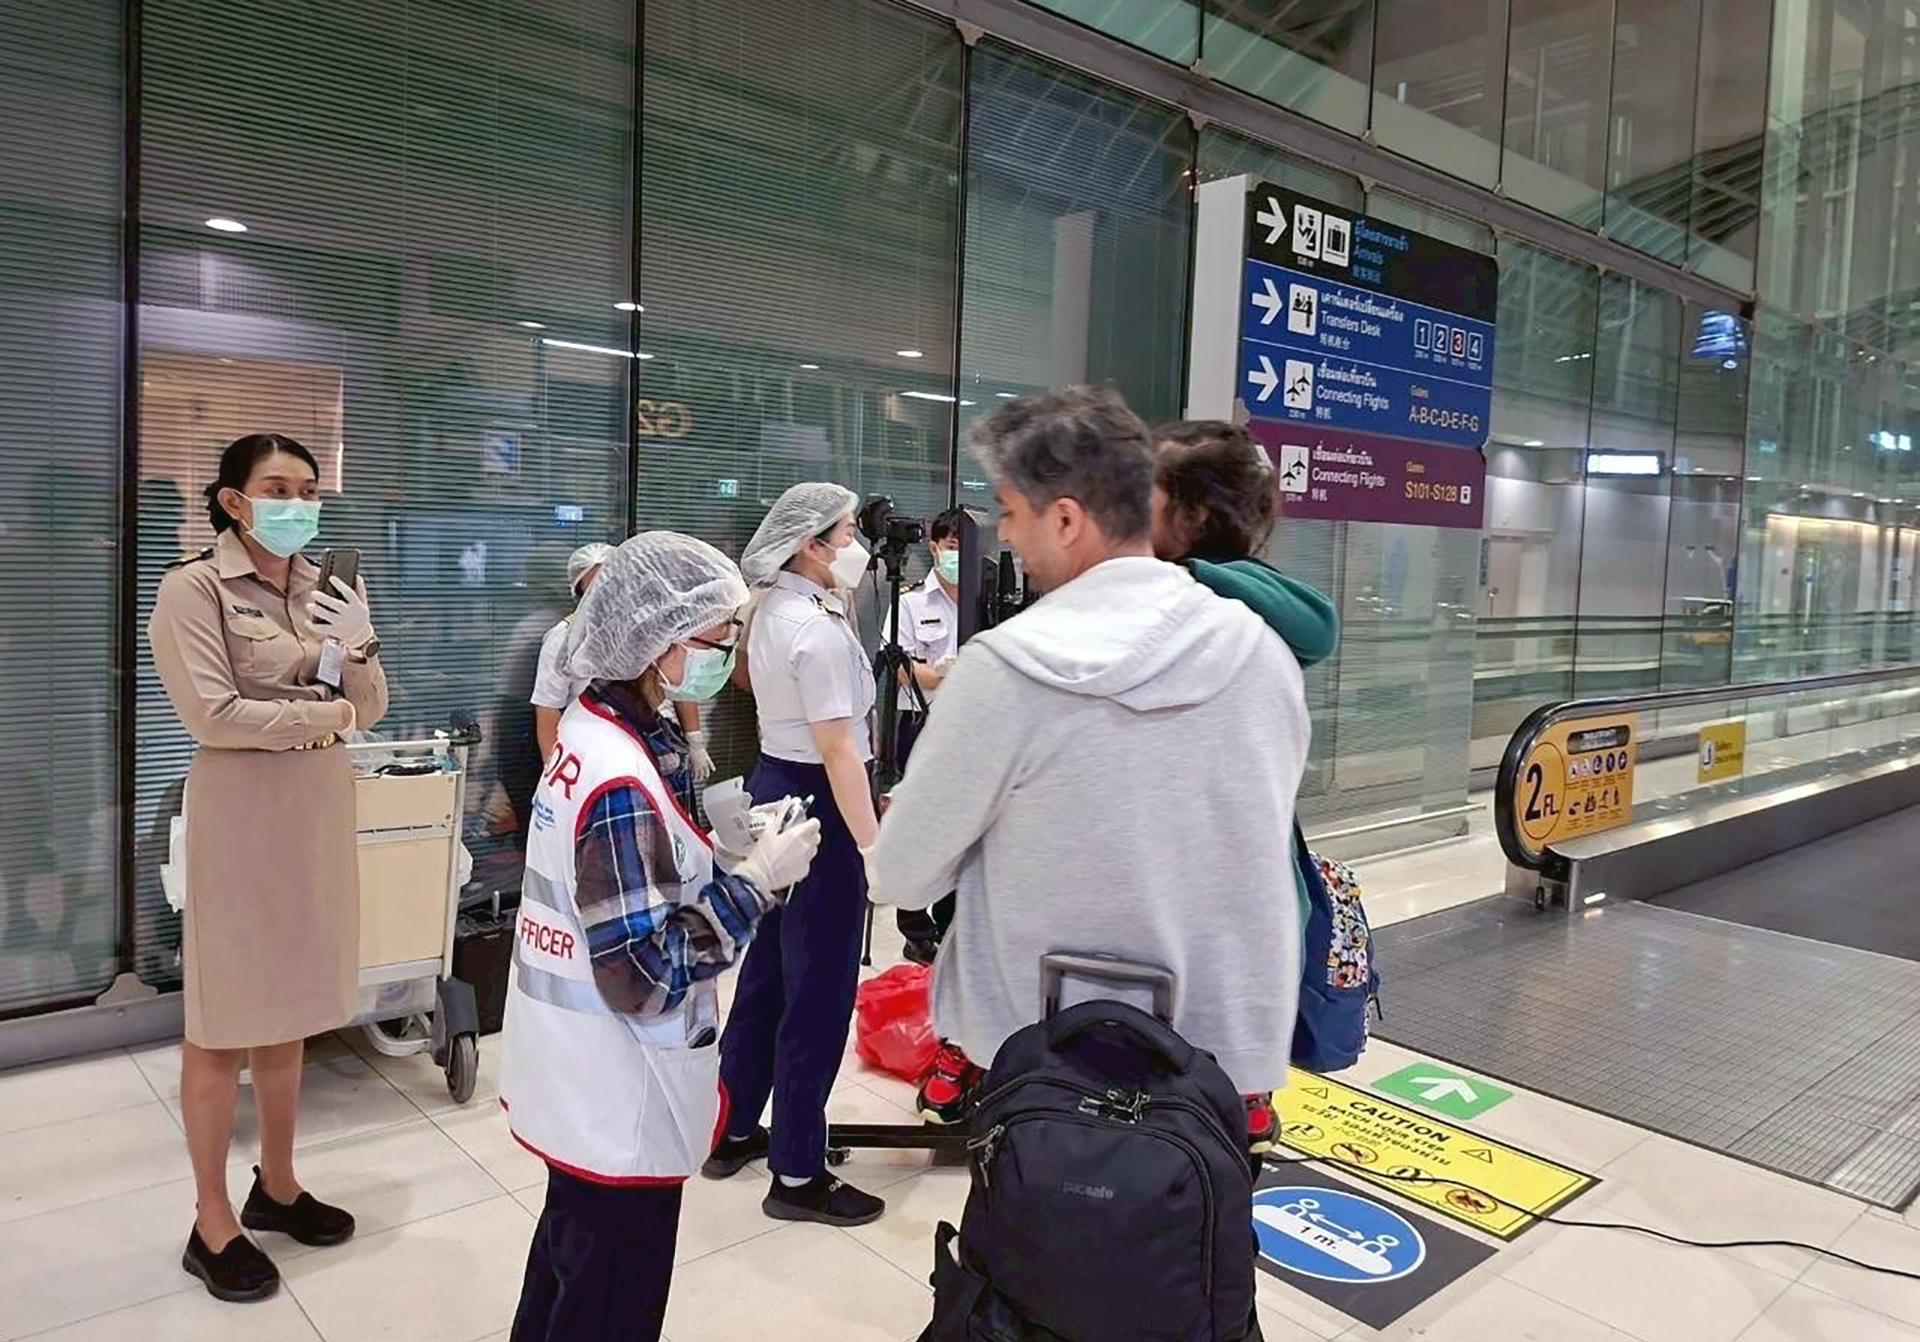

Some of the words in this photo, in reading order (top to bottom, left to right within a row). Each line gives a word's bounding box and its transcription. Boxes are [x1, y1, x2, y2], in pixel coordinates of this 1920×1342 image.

[1321, 310, 1360, 333] Transfers
[1360, 319, 1382, 337] Desk
[1419, 327, 1426, 344] 1
[1436, 330, 1445, 348] 2
[1454, 333, 1462, 351] 3
[1471, 338, 1479, 356] 4
[1316, 384, 1362, 409] Connecting
[1363, 392, 1390, 412] Flights
[1408, 405, 1479, 432] A-B-C-D-E-F-G
[1312, 467, 1359, 488] Connecting
[1360, 471, 1386, 489] Flights
[1525, 763, 1542, 821] 2
[1327, 1105, 1371, 1124] WATCH
[1374, 1122, 1410, 1140] YOUR
[1412, 1137, 1446, 1152] STEP
[1349, 1101, 1452, 1142] CAUTION
[1300, 1226, 1311, 1234] 1
